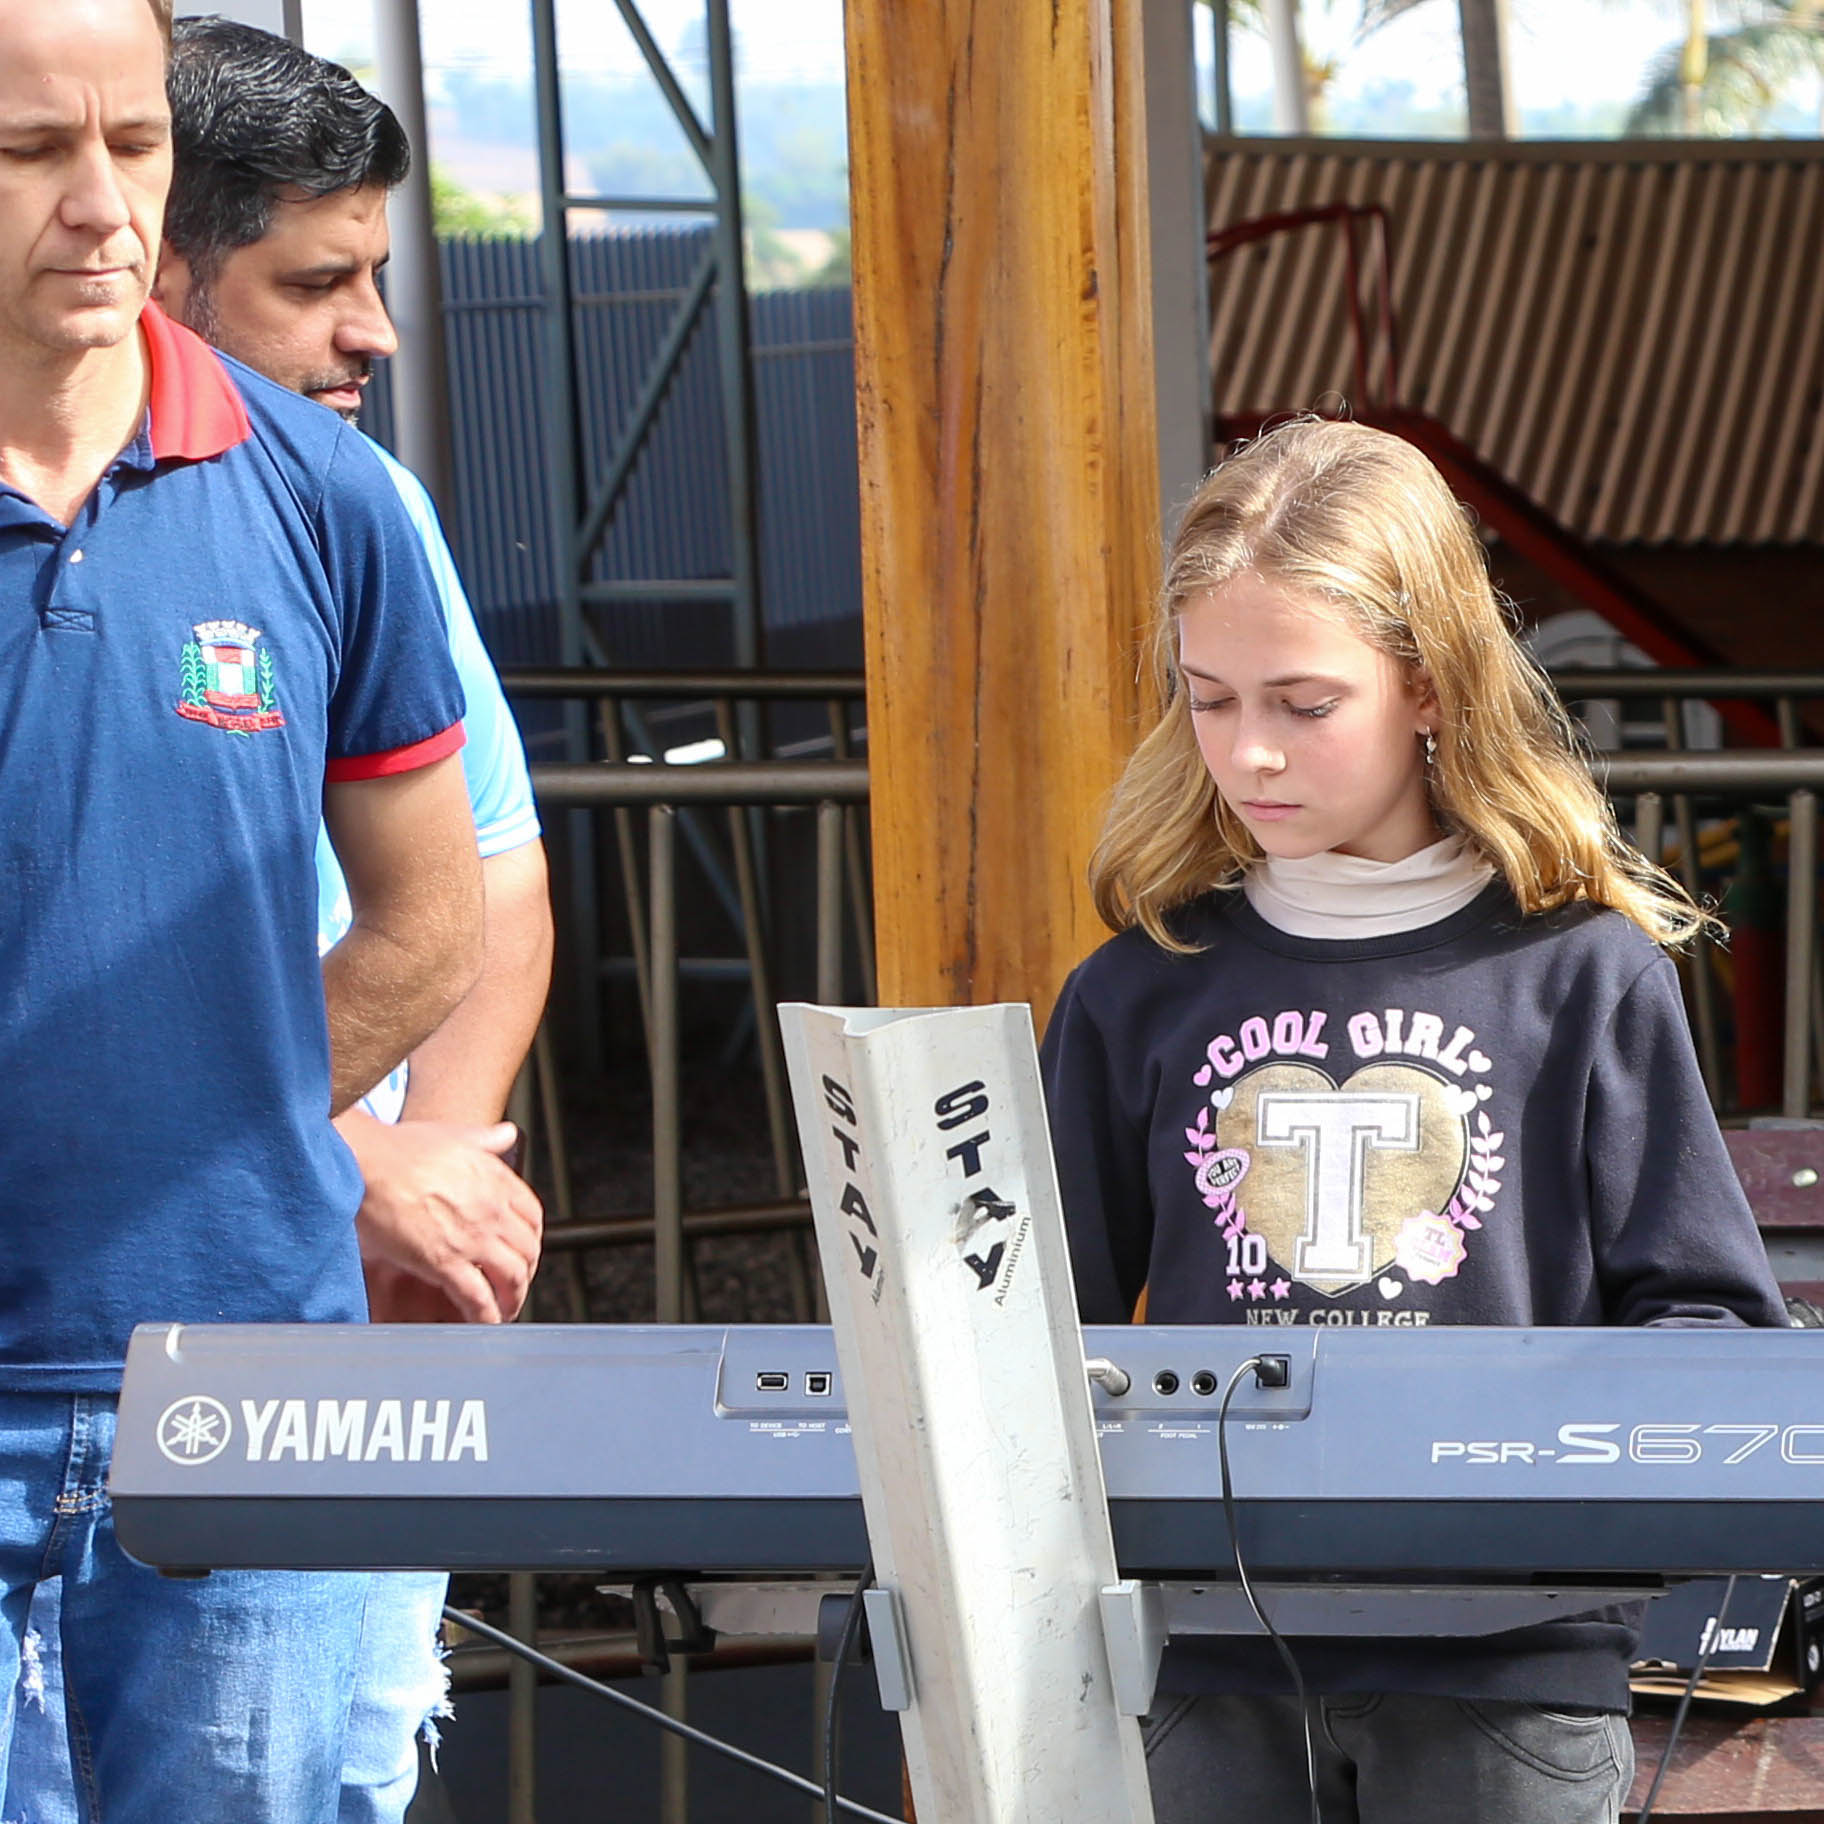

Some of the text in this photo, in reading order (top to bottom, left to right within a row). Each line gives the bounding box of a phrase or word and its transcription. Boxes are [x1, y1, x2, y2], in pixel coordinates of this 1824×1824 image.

[1206, 1008, 1476, 1079] COOL GIRL
[821, 1073, 879, 1279] STAY
[934, 1080, 1017, 1291] STAY
[1256, 1091, 1421, 1282] T
[993, 1215, 1031, 1306] Aluminium
[1225, 1233, 1268, 1276] 10
[241, 1399, 489, 1462] YAMAHA
